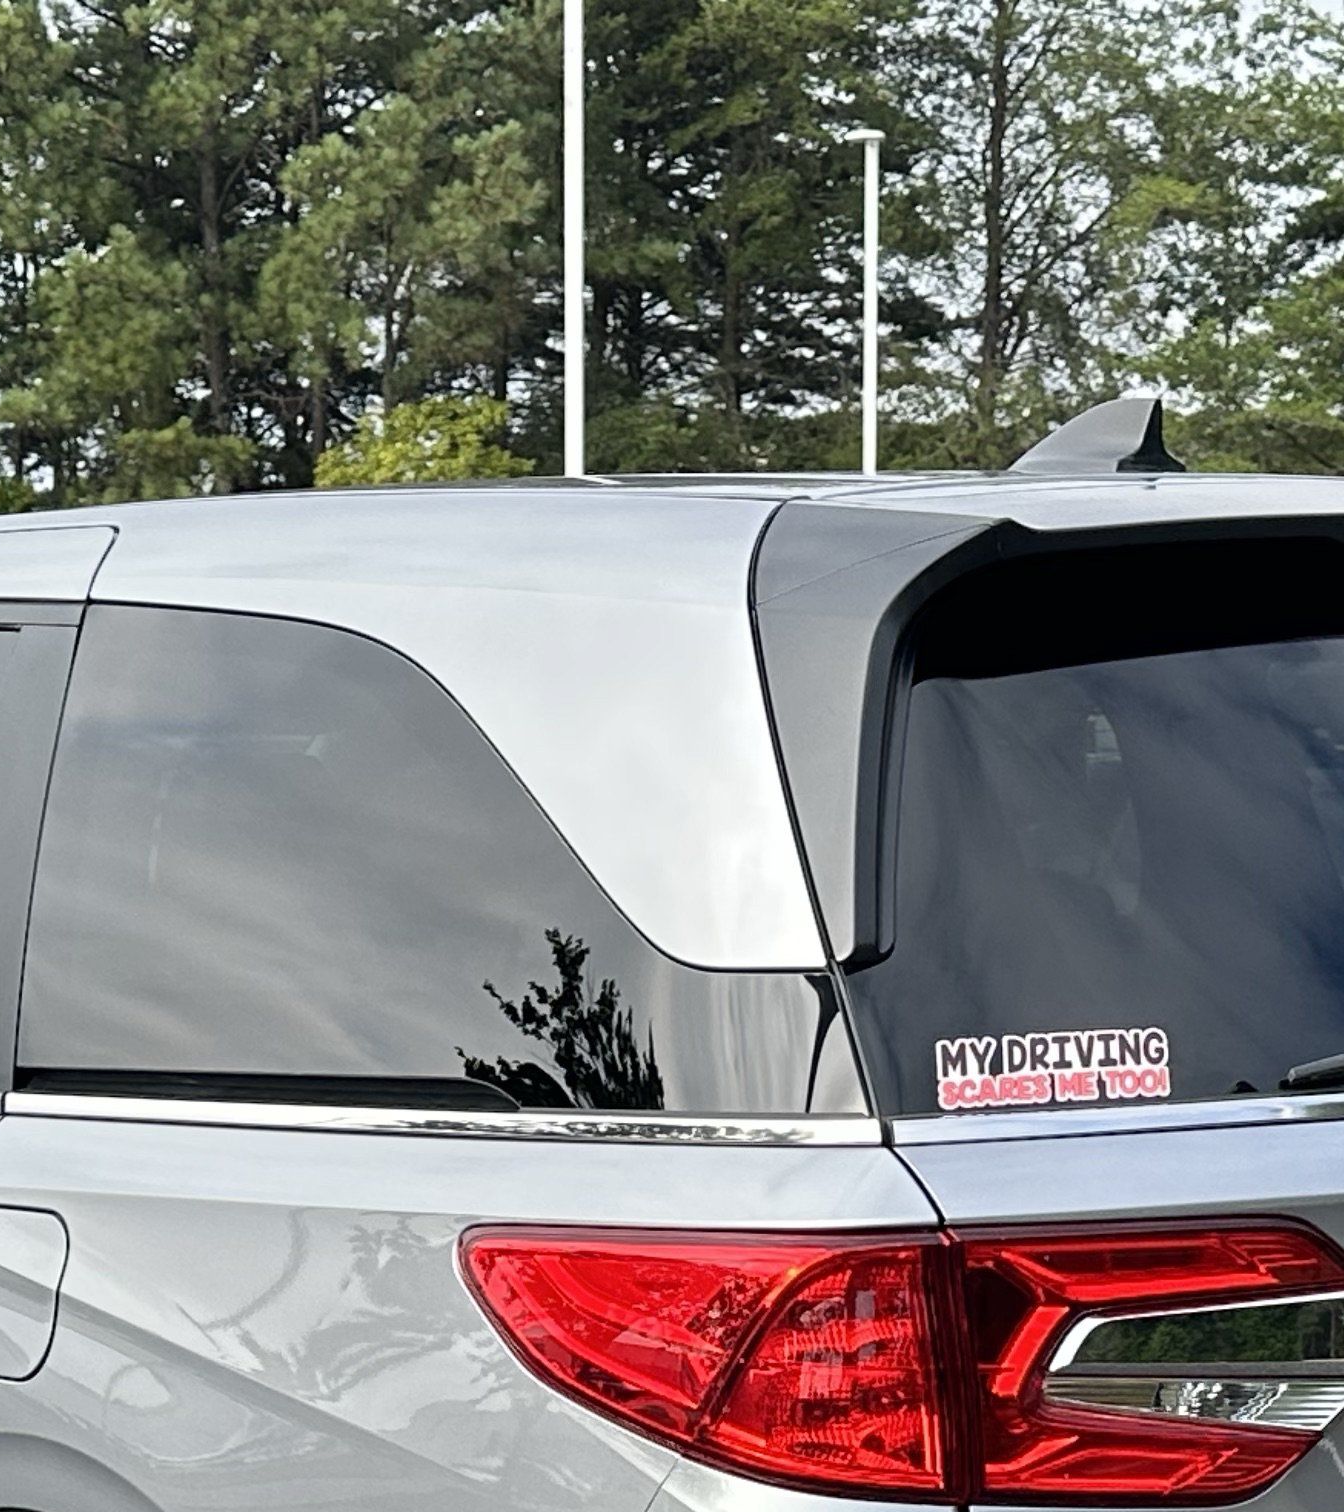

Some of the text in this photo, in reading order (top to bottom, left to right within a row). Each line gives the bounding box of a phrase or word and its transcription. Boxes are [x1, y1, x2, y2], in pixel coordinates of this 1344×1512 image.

[940, 1032, 1165, 1078] MY DRIVING
[941, 1067, 1168, 1106] SCARES ME TOO!
